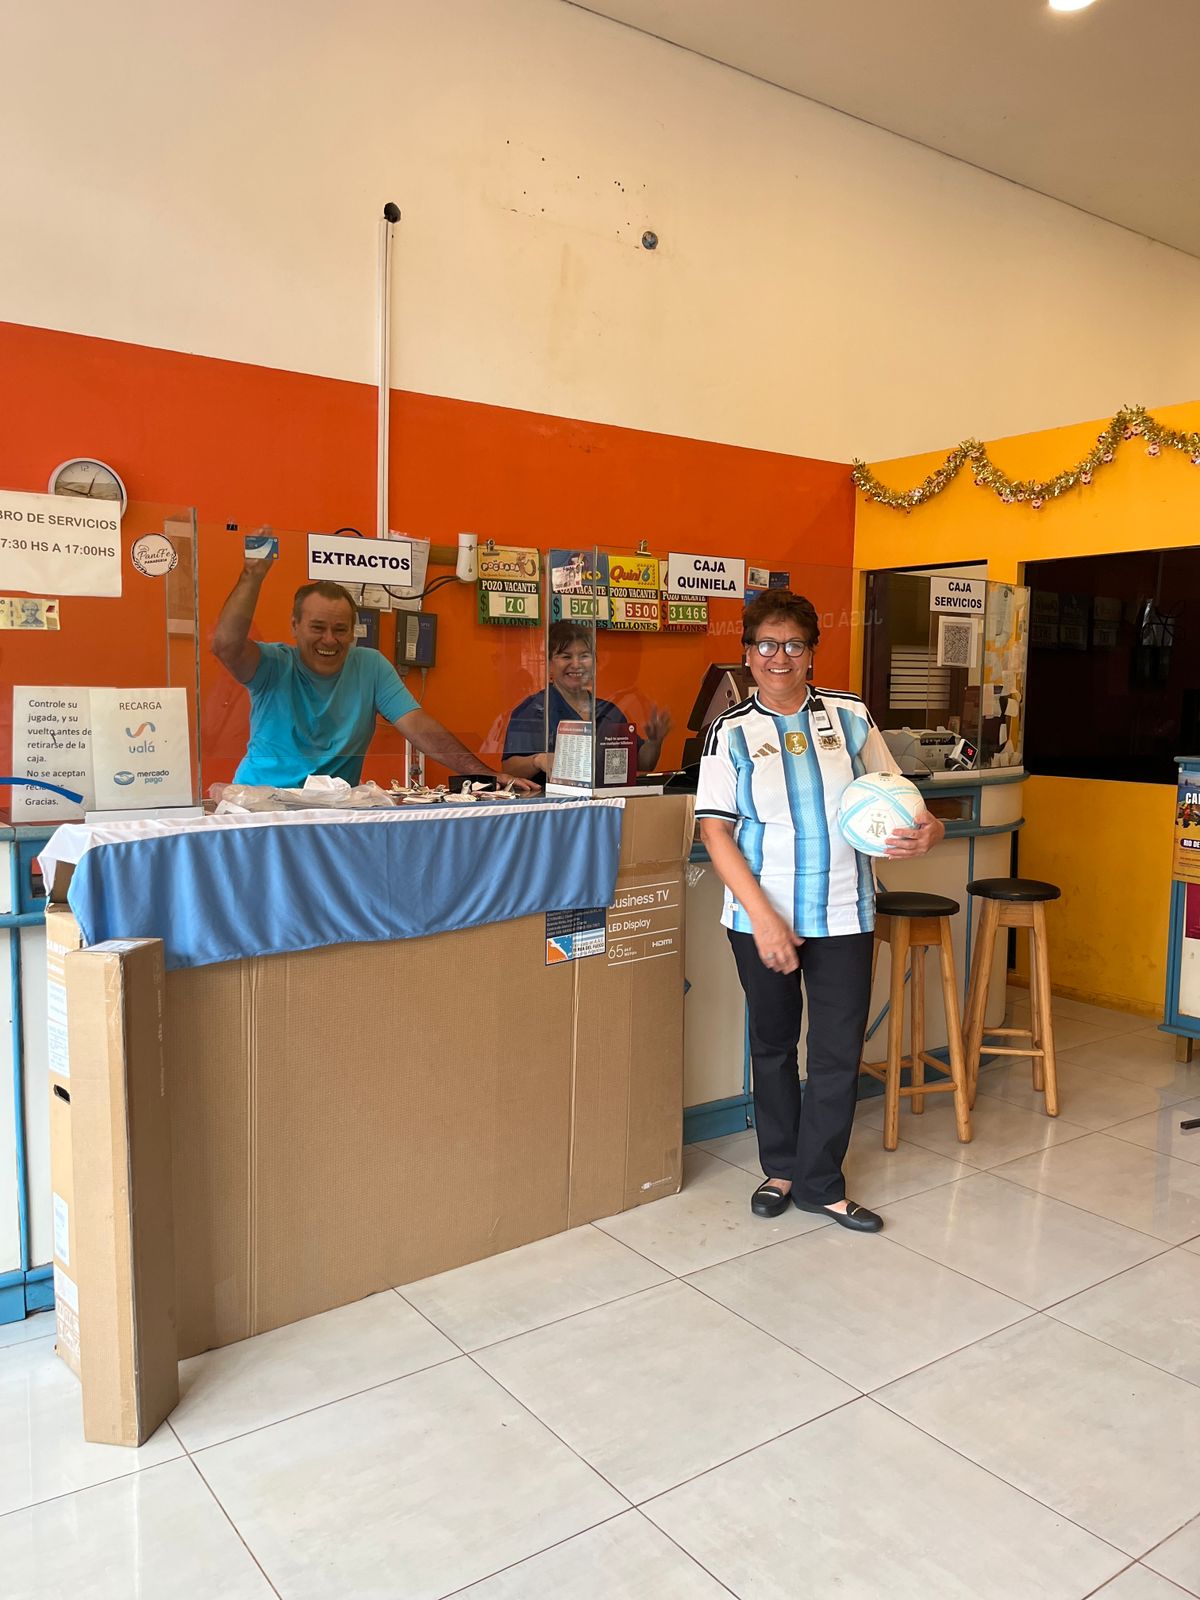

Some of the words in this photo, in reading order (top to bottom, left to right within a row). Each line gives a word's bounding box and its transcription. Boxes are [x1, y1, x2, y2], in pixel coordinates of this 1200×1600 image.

[27, 512, 45, 524] DE
[49, 514, 117, 531] SERVICIOS
[1, 538, 28, 550] 7:30
[31, 541, 49, 552] HS
[52, 543, 62, 554] A
[65, 544, 116, 558] 17:00HS
[312, 551, 411, 571] EXTRACTOS
[694, 559, 726, 573] CAJA
[610, 564, 641, 583] Quini
[482, 580, 502, 591] POZO
[504, 582, 537, 593] VACANTE
[677, 576, 737, 591] QUINIELA
[948, 581, 972, 593] CAJA
[610, 588, 627, 597] POZO
[629, 589, 657, 599] VACANTE
[506, 598, 524, 612] 70
[553, 597, 560, 616] $
[934, 596, 982, 609] SERVICIOS
[626, 603, 658, 617] 5500
[670, 606, 707, 619] 31466
[611, 622, 658, 630] MILLONES
[663, 624, 708, 632] MILLONES
[29, 700, 66, 709] Controle
[119, 702, 162, 710] RECARGA
[28, 714, 60, 724] jugada,
[28, 728, 55, 736] vuelto
[57, 729, 80, 737] antes
[82, 728, 92, 736] de
[28, 741, 64, 749] retirarse
[66, 741, 77, 749] de
[78, 741, 86, 749] la
[27, 755, 47, 764] caja.
[52, 770, 86, 779] aceptan
[137, 769, 170, 778] mercado
[144, 776, 163, 785] pago
[25, 798, 59, 806] Gracias.
[867, 820, 887, 838] AFA
[656, 889, 670, 902] TV
[608, 921, 623, 933] LED
[624, 919, 651, 931] Display
[608, 943, 624, 959] 65
